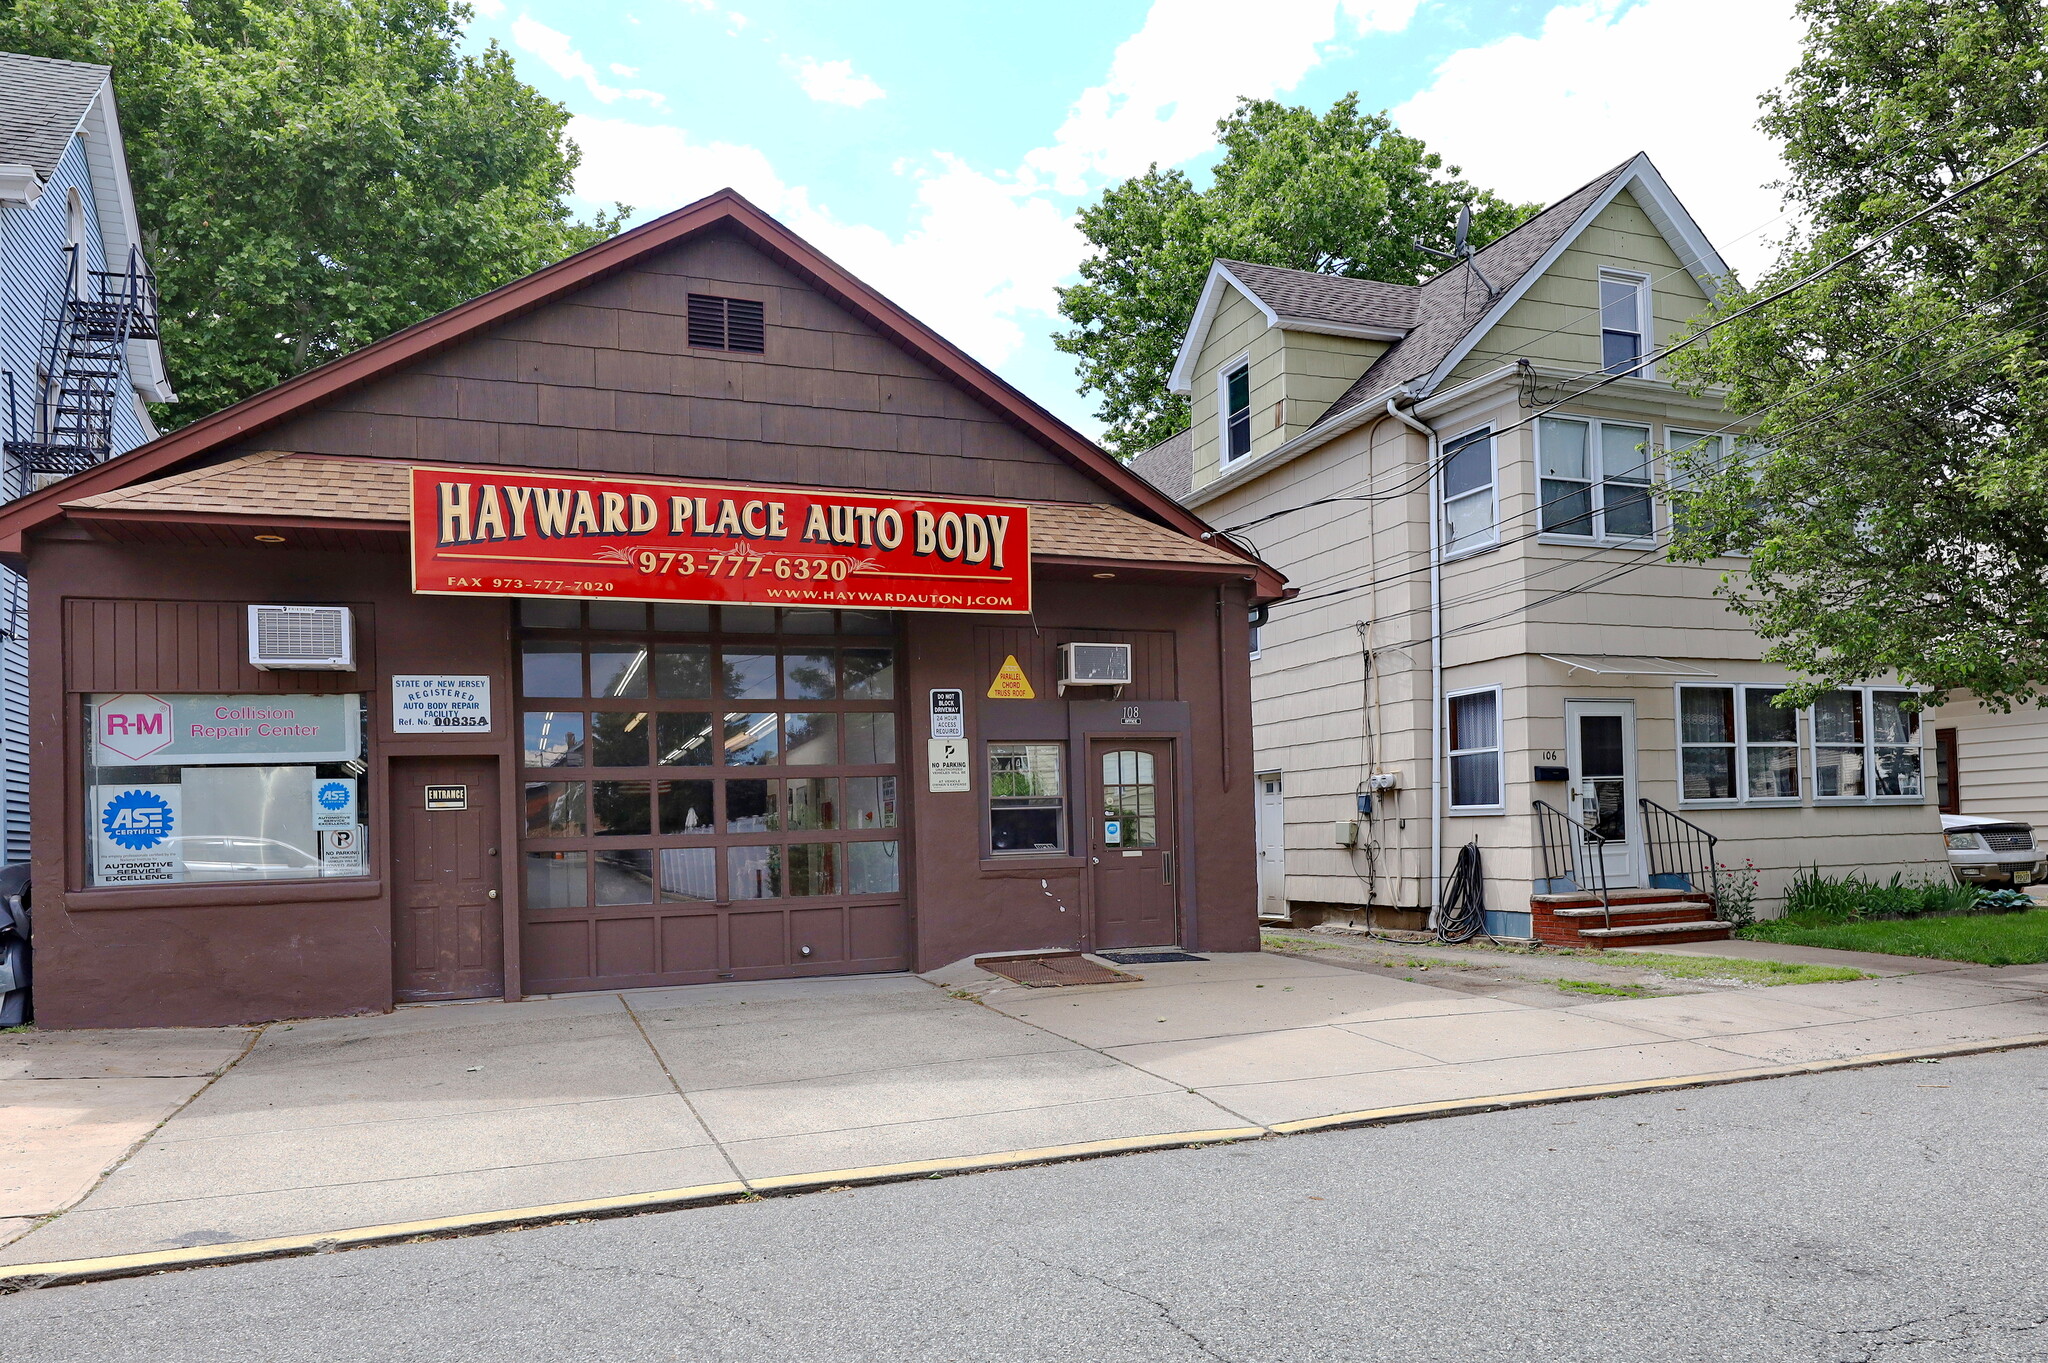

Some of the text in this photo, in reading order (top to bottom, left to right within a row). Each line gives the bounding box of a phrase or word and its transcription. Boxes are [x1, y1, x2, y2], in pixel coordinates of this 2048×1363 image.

[437, 482, 1010, 569] HAYWARD PLACE AUTO BODY
[639, 551, 846, 582] 973-777-6320
[448, 576, 614, 592] FAX 973-777-7020
[408, 689, 474, 701] REGISTERED
[215, 706, 294, 720] Collision
[1123, 706, 1139, 718] 108
[107, 713, 162, 735] R-M
[434, 716, 489, 726] 00835A
[190, 723, 319, 740] Repair Center
[1543, 751, 1557, 760] 106
[322, 791, 345, 800] ASE
[428, 790, 464, 799] ENTRANCE
[111, 808, 162, 829] ASE
